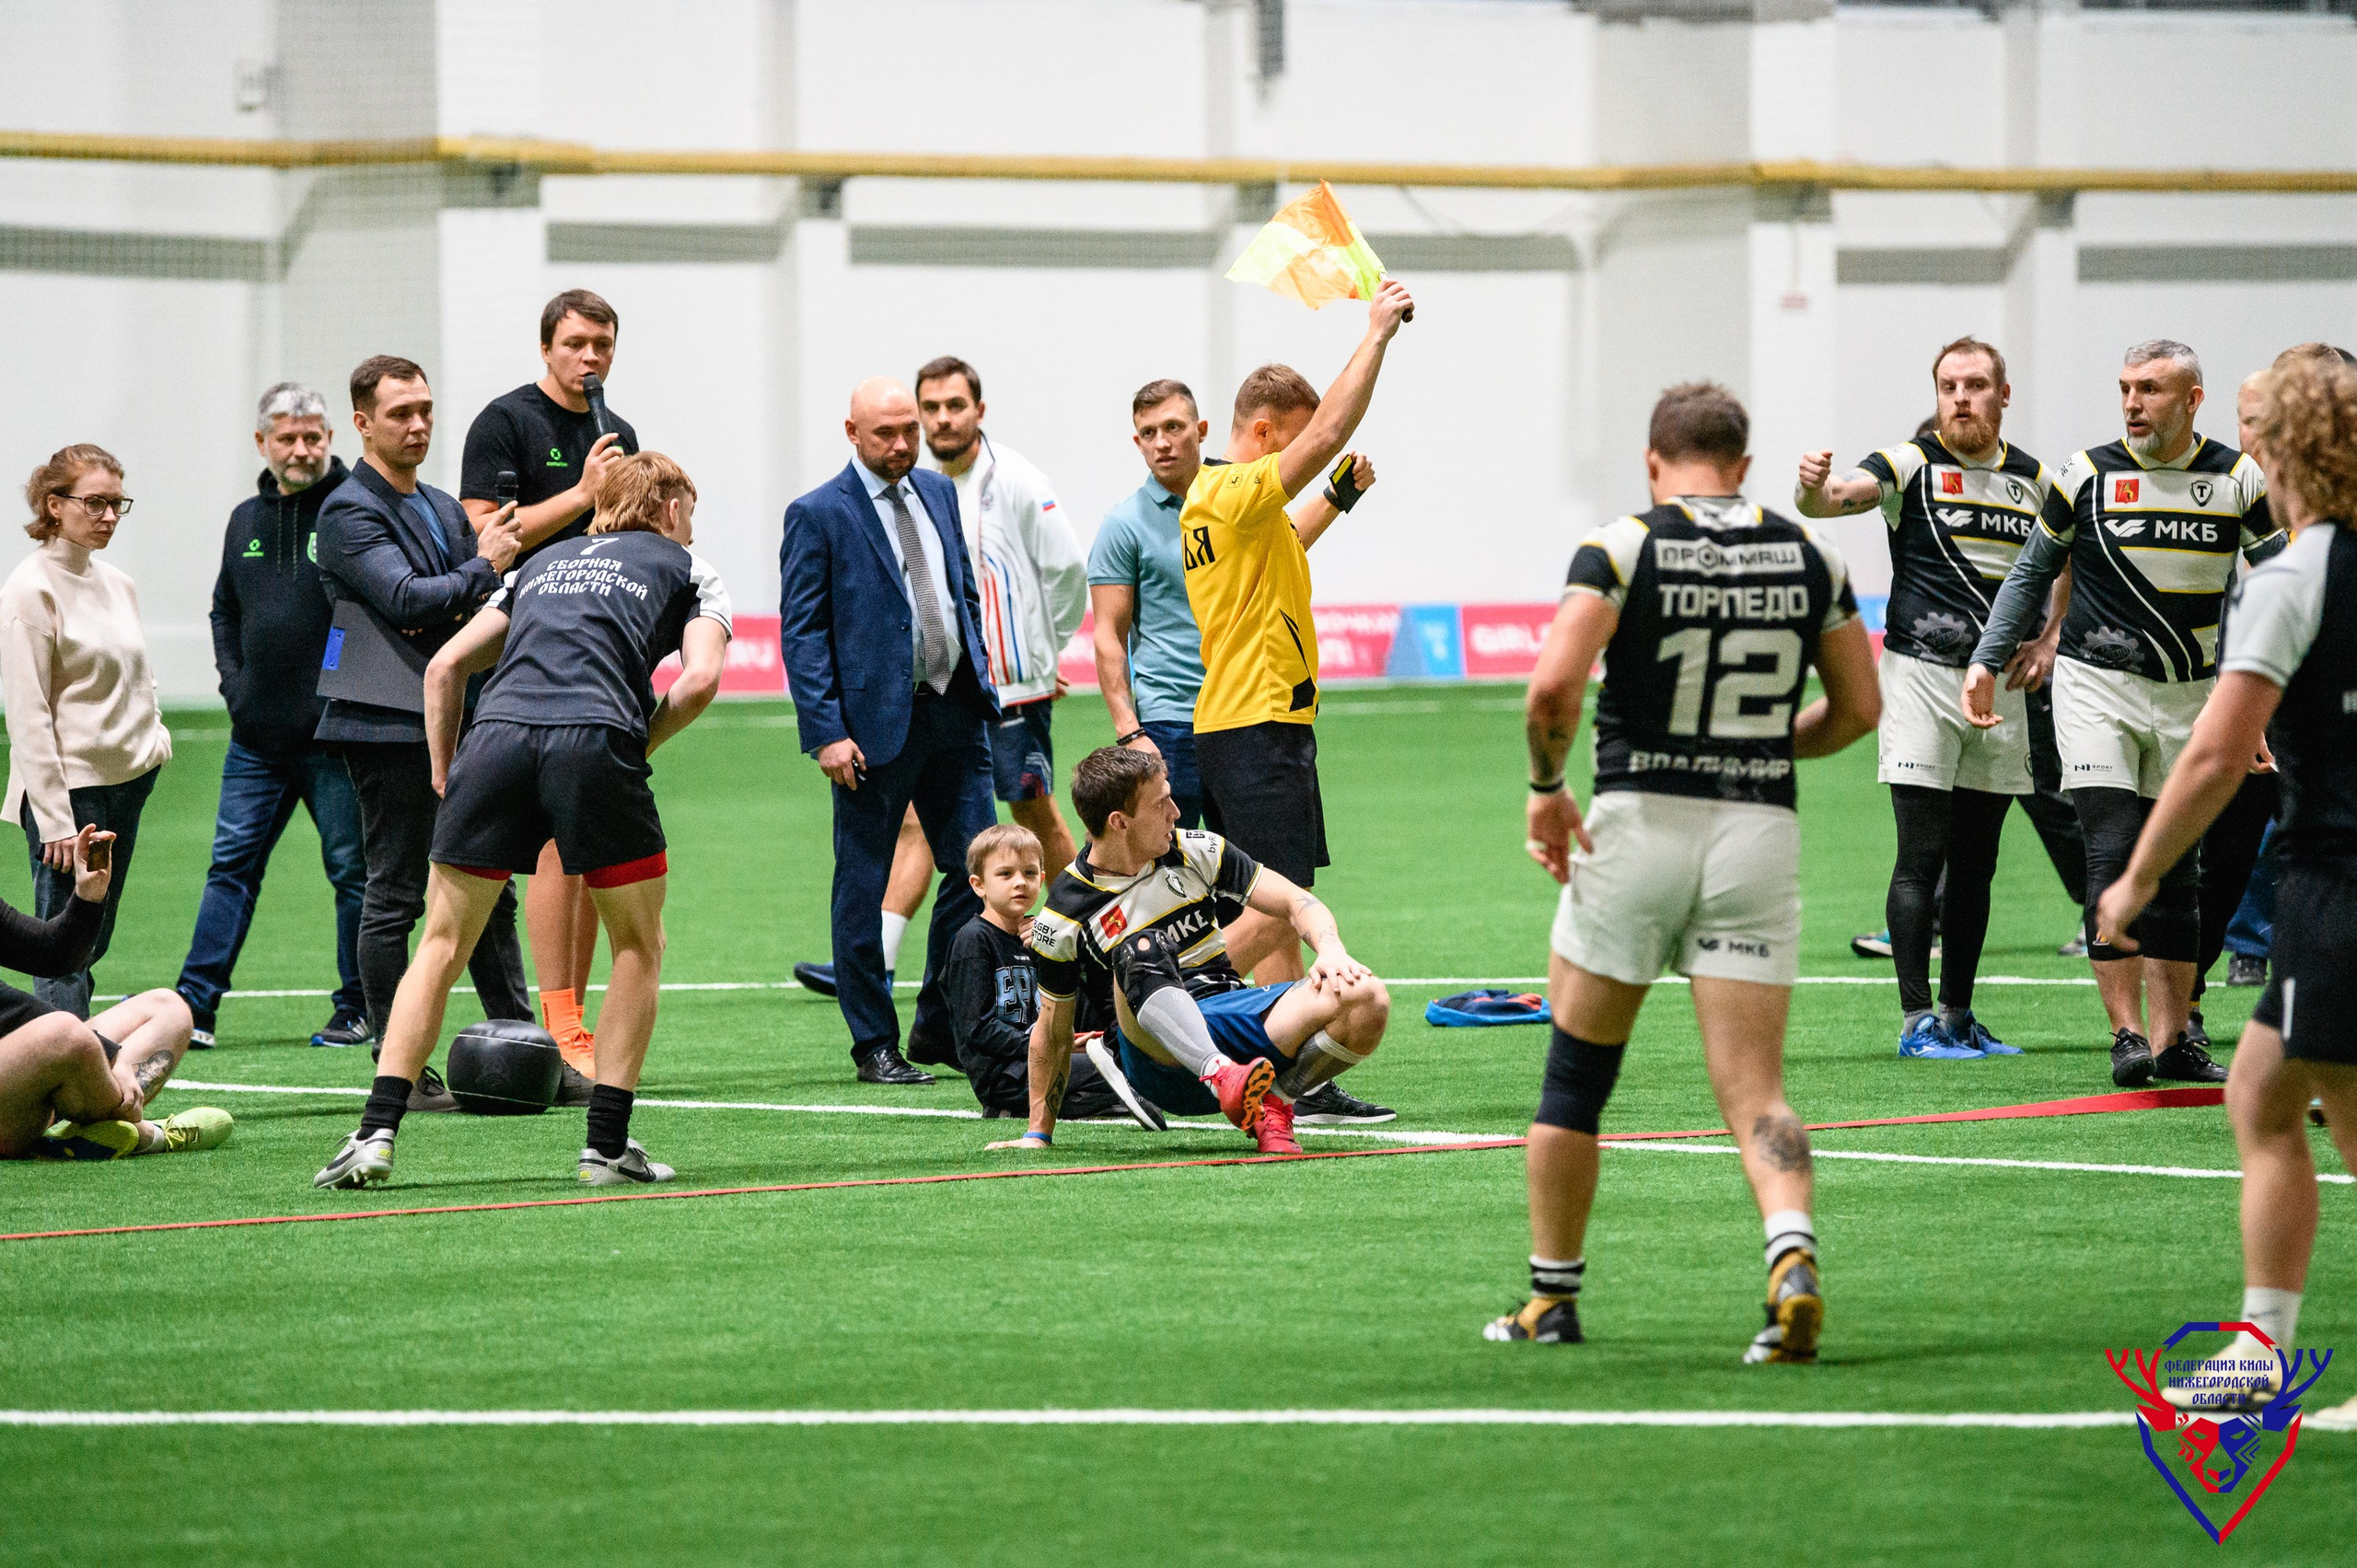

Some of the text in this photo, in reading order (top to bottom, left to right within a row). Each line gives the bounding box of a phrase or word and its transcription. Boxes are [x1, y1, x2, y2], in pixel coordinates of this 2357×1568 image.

[1980, 512, 2032, 537] МКБ
[2154, 519, 2219, 543] МКБ
[579, 537, 620, 555] 7
[546, 557, 622, 572] СБОРНАЯ
[518, 569, 648, 601] НИЖЕГОРОДСКОЙ
[538, 581, 612, 597] ОБЛАСТИ
[1658, 584, 1810, 621] ТОРПЕДО
[1658, 628, 1804, 738] 12
